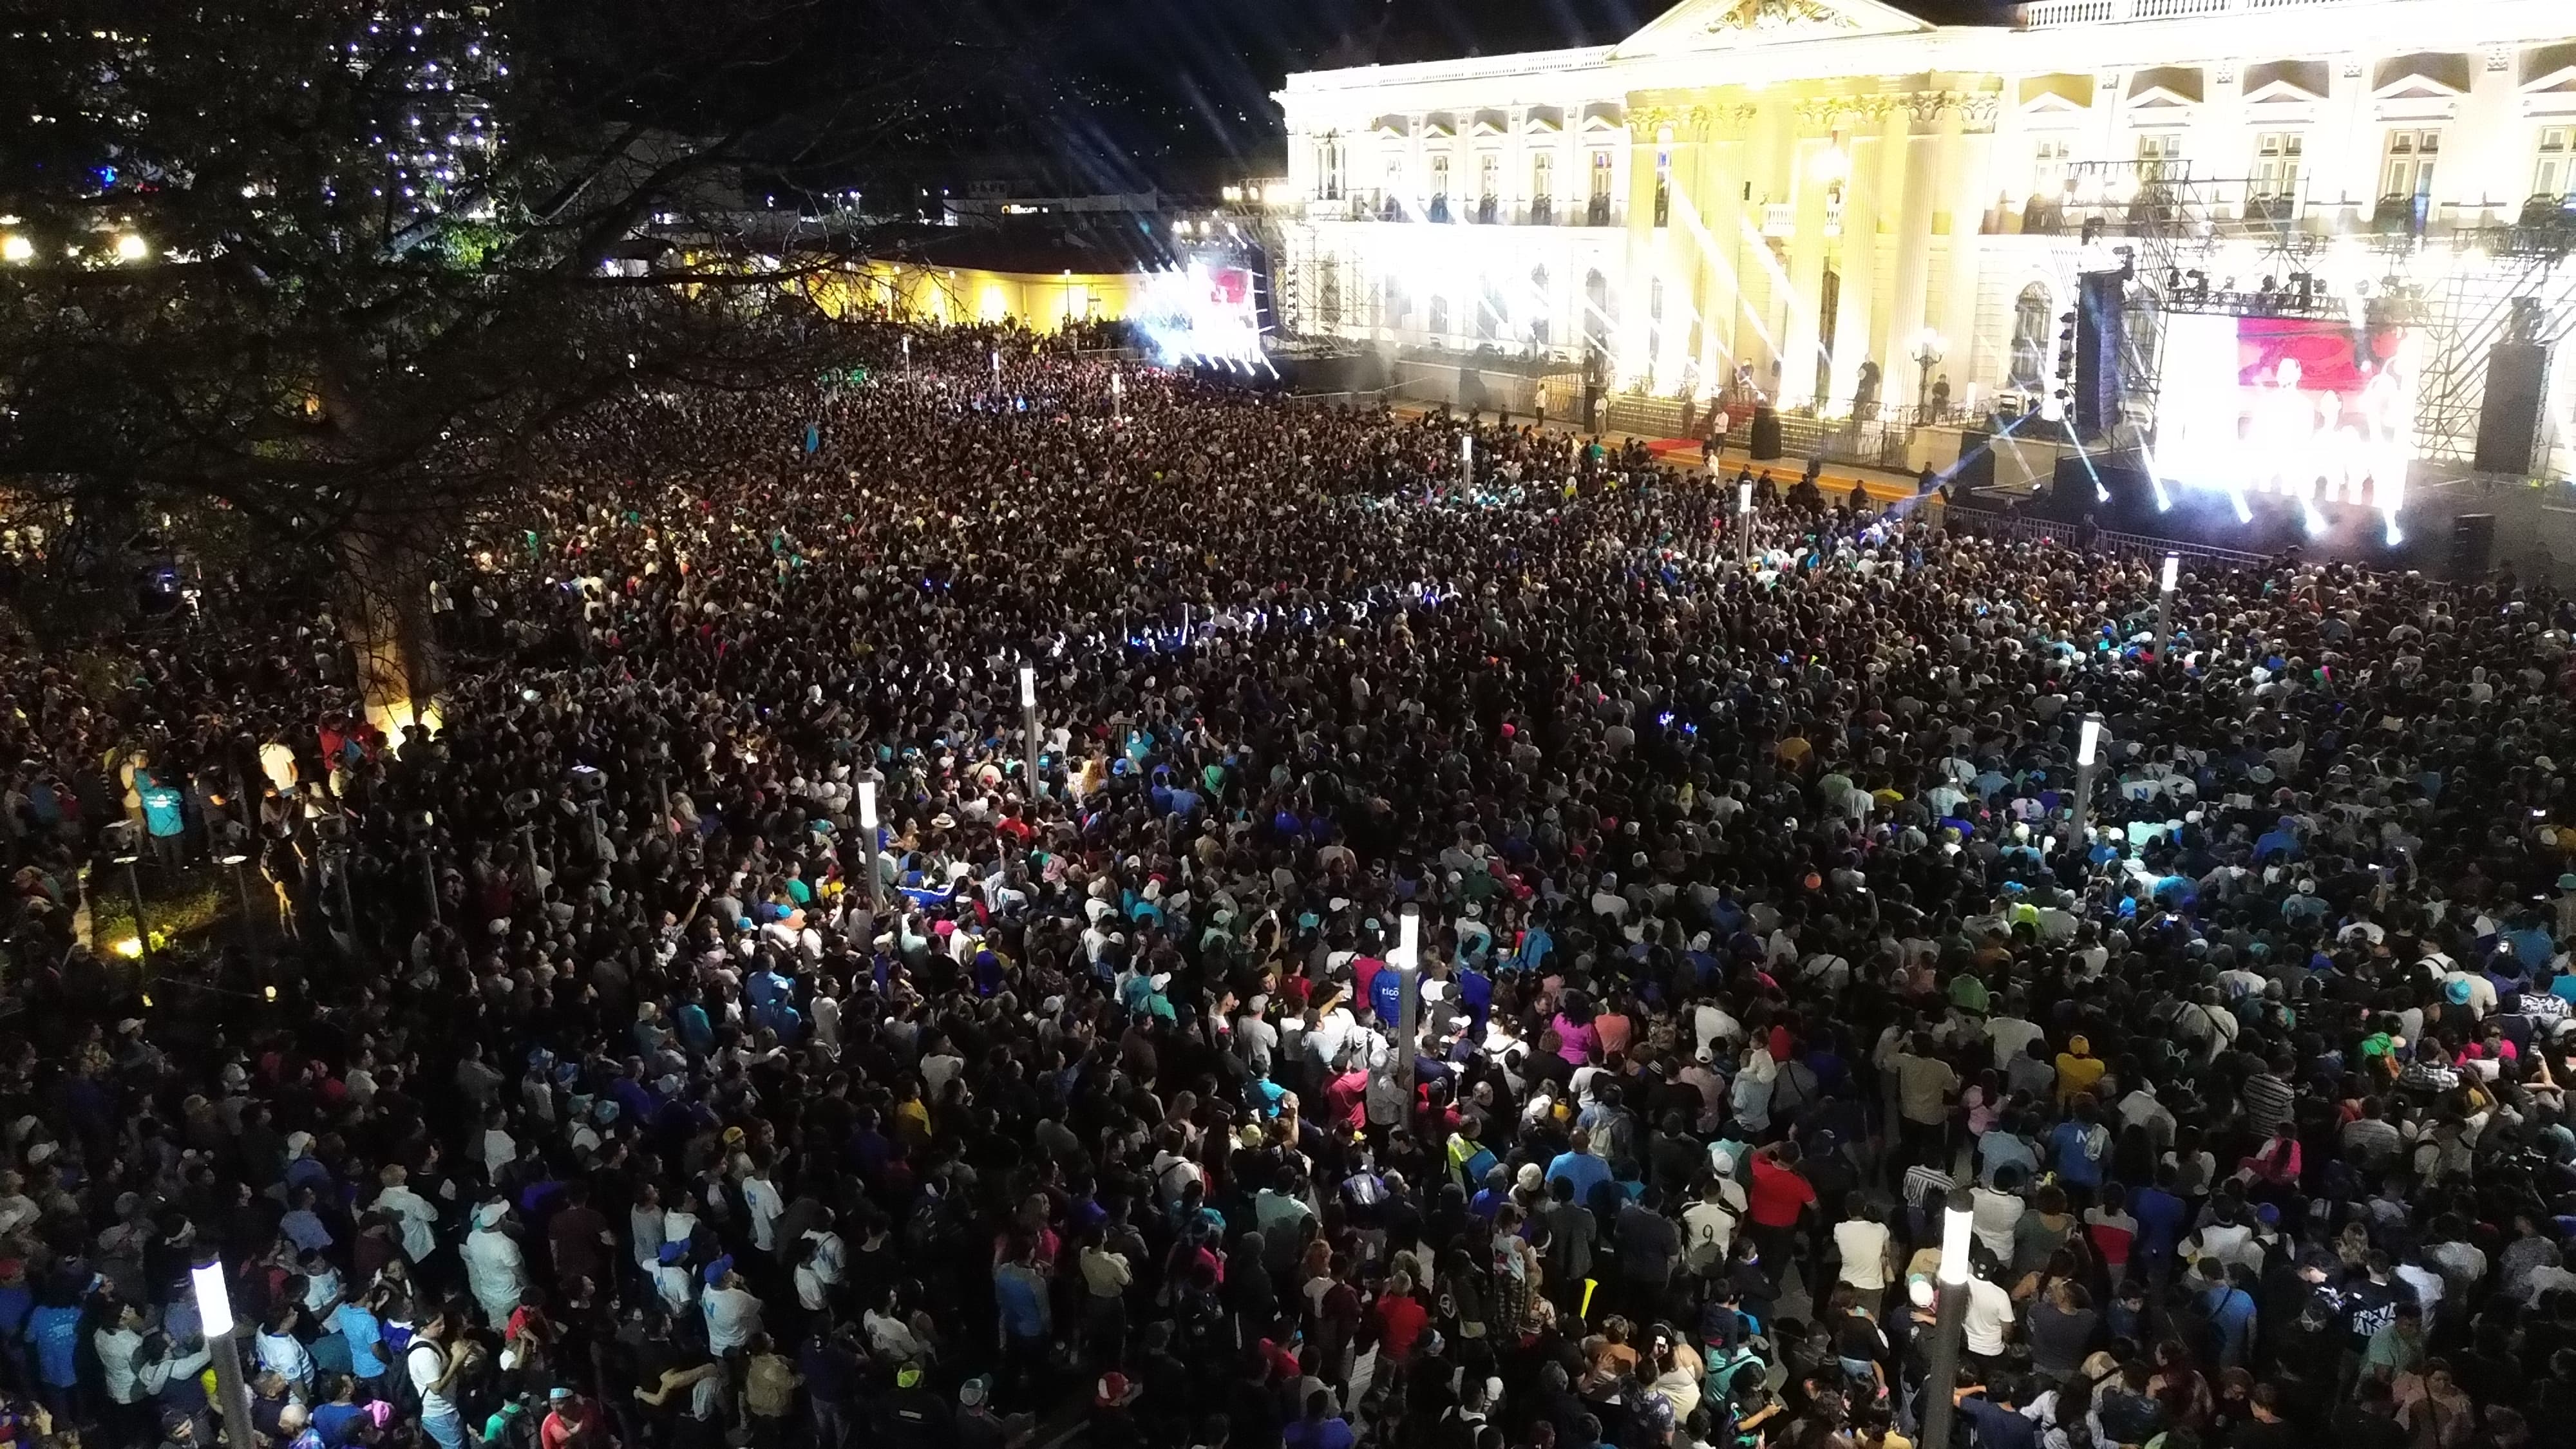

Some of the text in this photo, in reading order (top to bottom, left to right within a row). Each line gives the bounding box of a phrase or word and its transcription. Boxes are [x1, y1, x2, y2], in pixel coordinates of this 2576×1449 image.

[2207, 771, 2217, 779] N
[2134, 788, 2148, 799] N
[2346, 810, 2361, 823] N
[1002, 893, 1010, 902] N
[2076, 1129, 2090, 1144] N
[1702, 1224, 1714, 1246] 9
